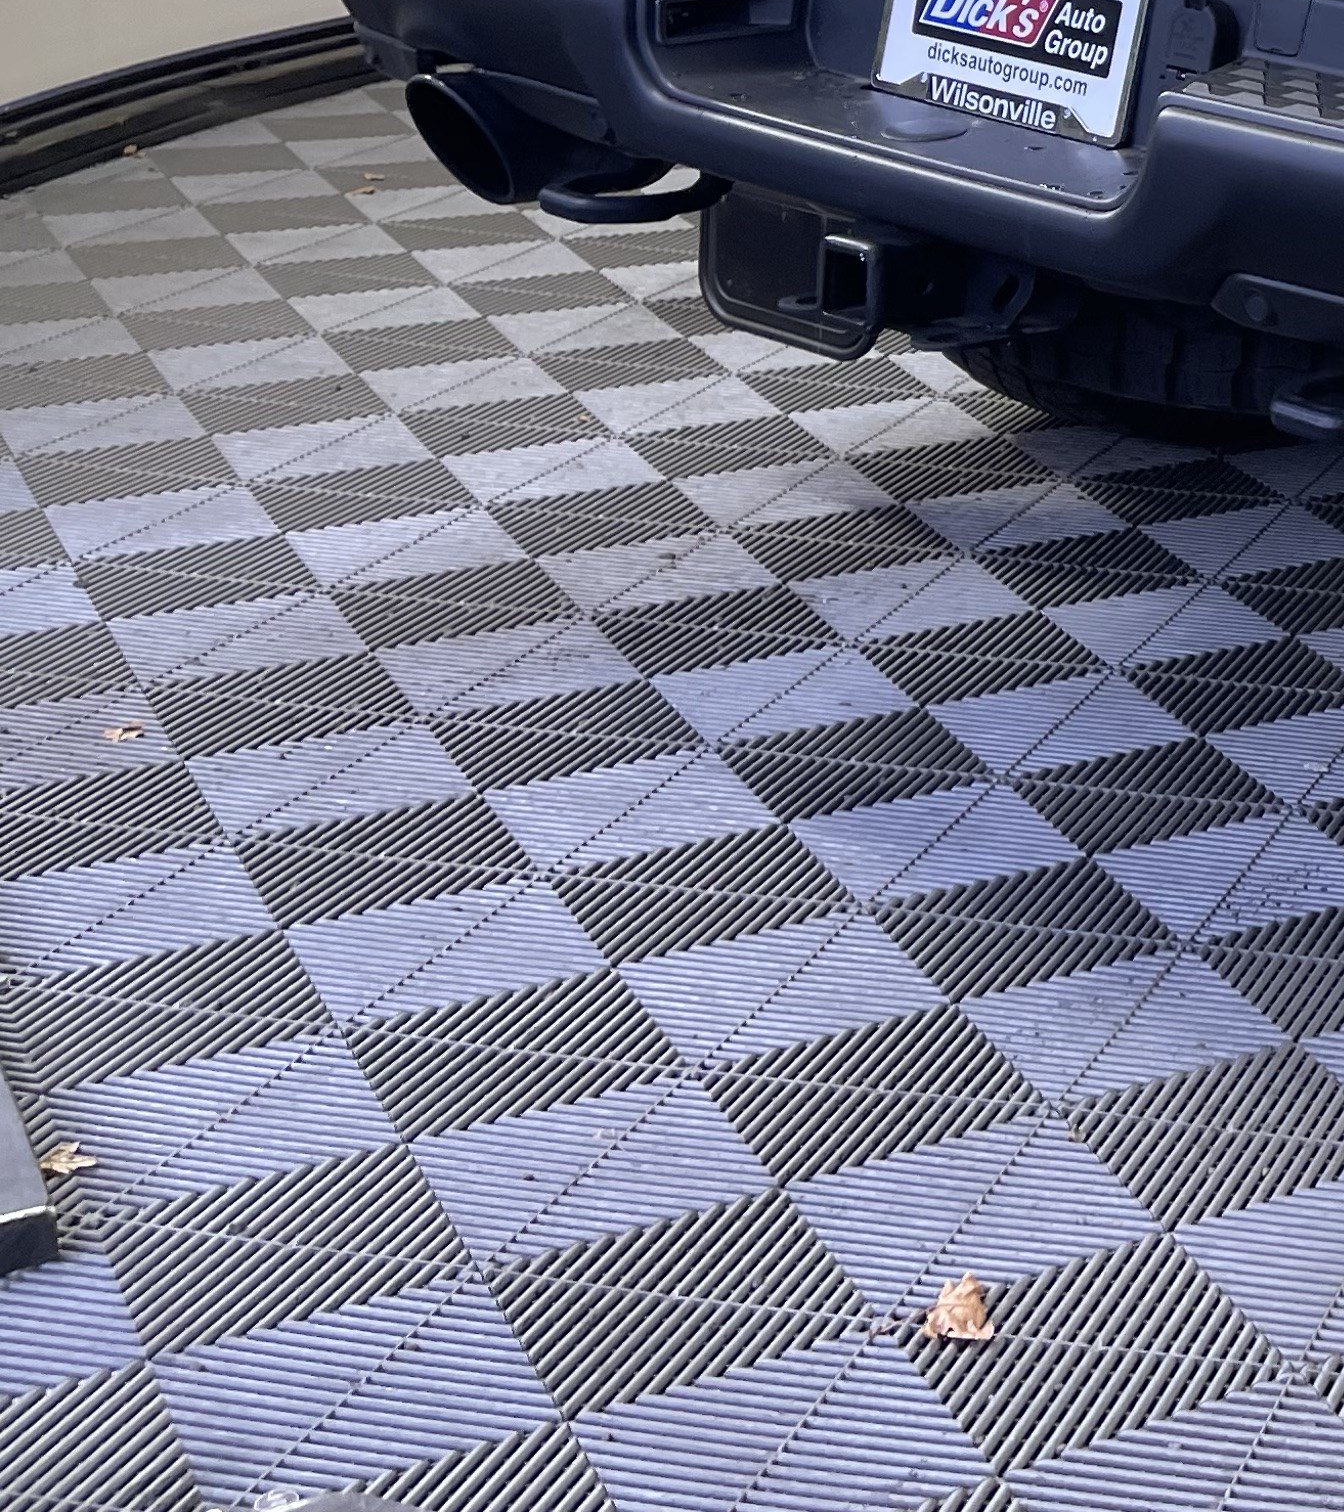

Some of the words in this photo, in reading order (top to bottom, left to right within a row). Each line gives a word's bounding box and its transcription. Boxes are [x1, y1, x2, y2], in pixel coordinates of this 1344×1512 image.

[1054, 1, 1107, 34] Auto
[926, 41, 1089, 97] dicksautogroup.com
[1044, 28, 1109, 70] Group
[928, 74, 1057, 130] Wilsonville
